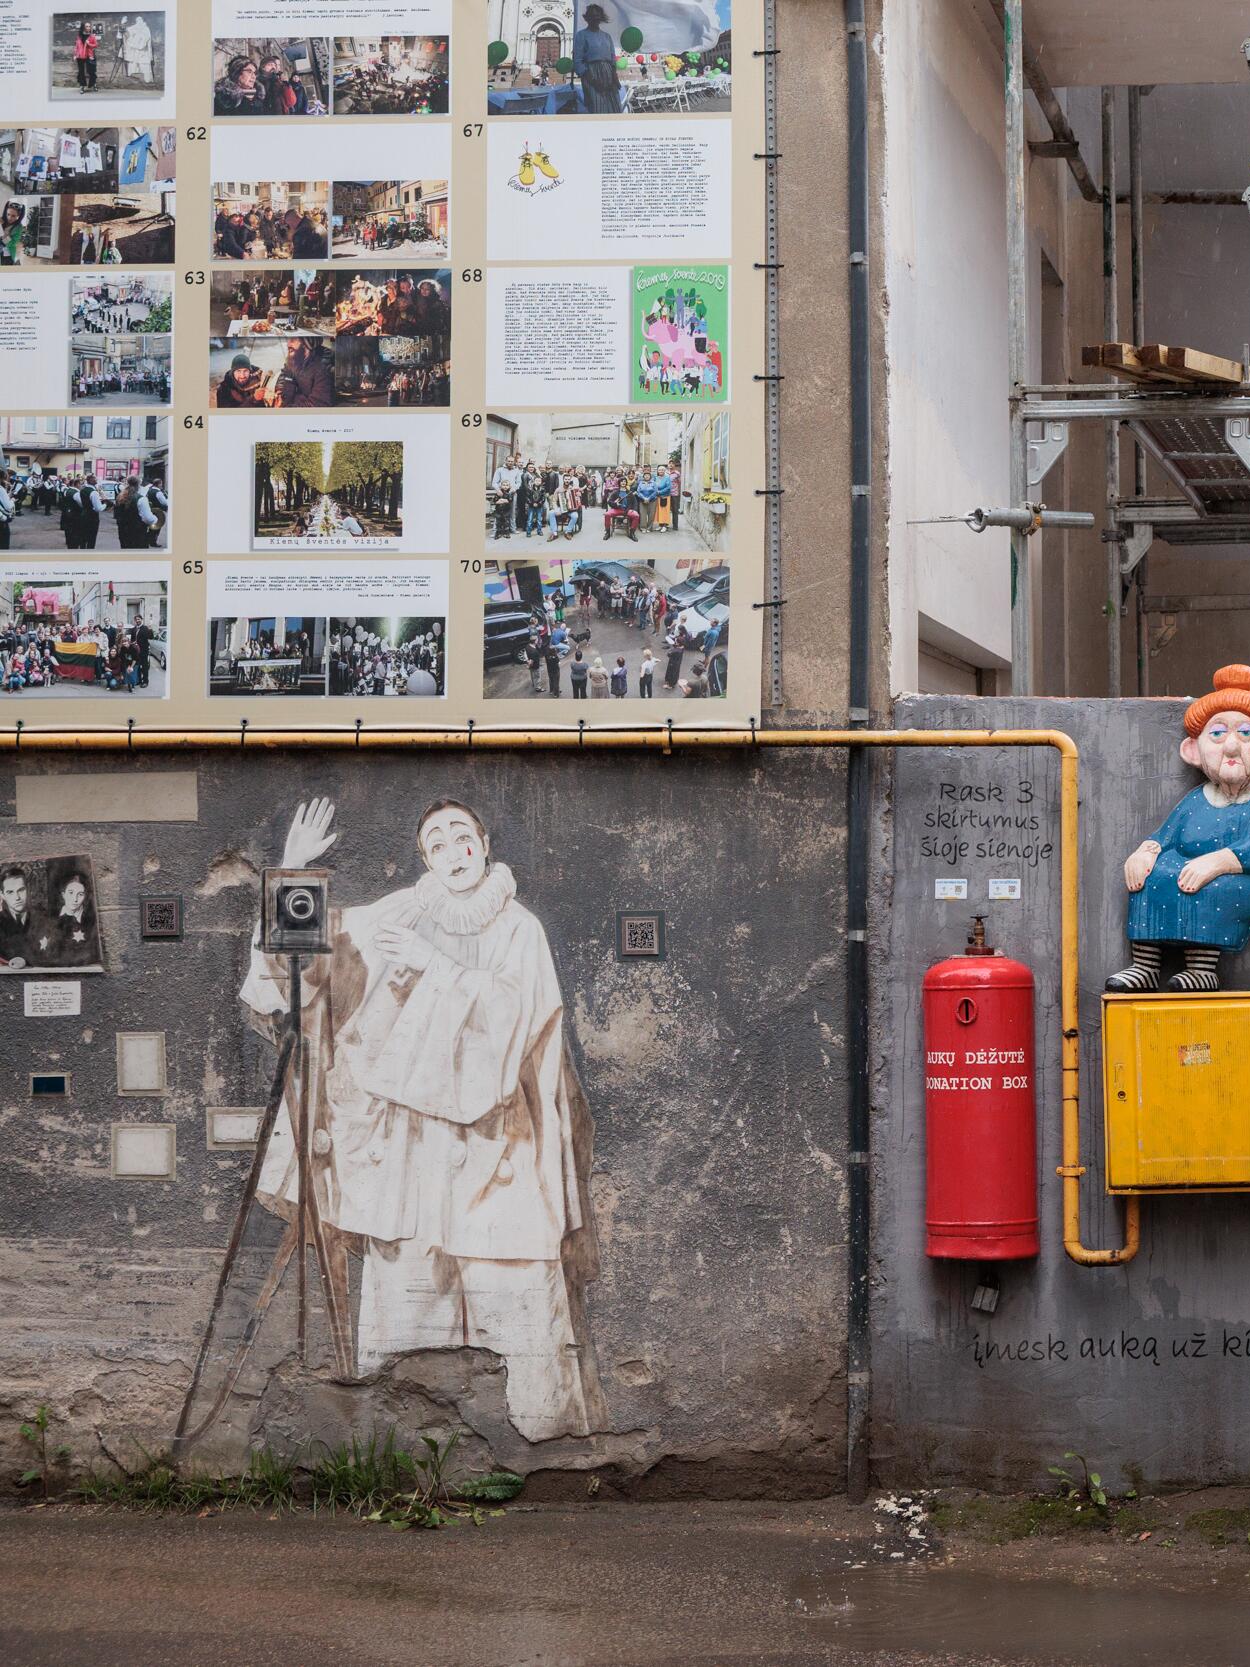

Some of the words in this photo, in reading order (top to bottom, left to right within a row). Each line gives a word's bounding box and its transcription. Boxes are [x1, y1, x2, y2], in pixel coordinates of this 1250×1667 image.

[186, 126, 207, 141] 62
[462, 123, 484, 138] 67
[184, 270, 205, 285] 63
[461, 268, 483, 283] 68
[183, 415, 204, 429] 64
[461, 413, 483, 428] 69
[354, 537, 390, 546] vizija
[183, 560, 204, 575] 65
[460, 559, 482, 574] 70
[940, 782, 1004, 802] Rask
[1017, 781, 1034, 804] 3
[924, 804, 1040, 830] skirtumus
[921, 834, 970, 866] šioje
[975, 836, 1053, 868] sienoje
[927, 1051, 956, 1067] AUKŲ
[965, 1047, 1025, 1065] DĖŽUTĖ
[1002, 1076, 1028, 1089] BOX
[972, 1332, 1070, 1369] įmesk
[1079, 1330, 1161, 1367] auką
[1172, 1331, 1208, 1359] už
